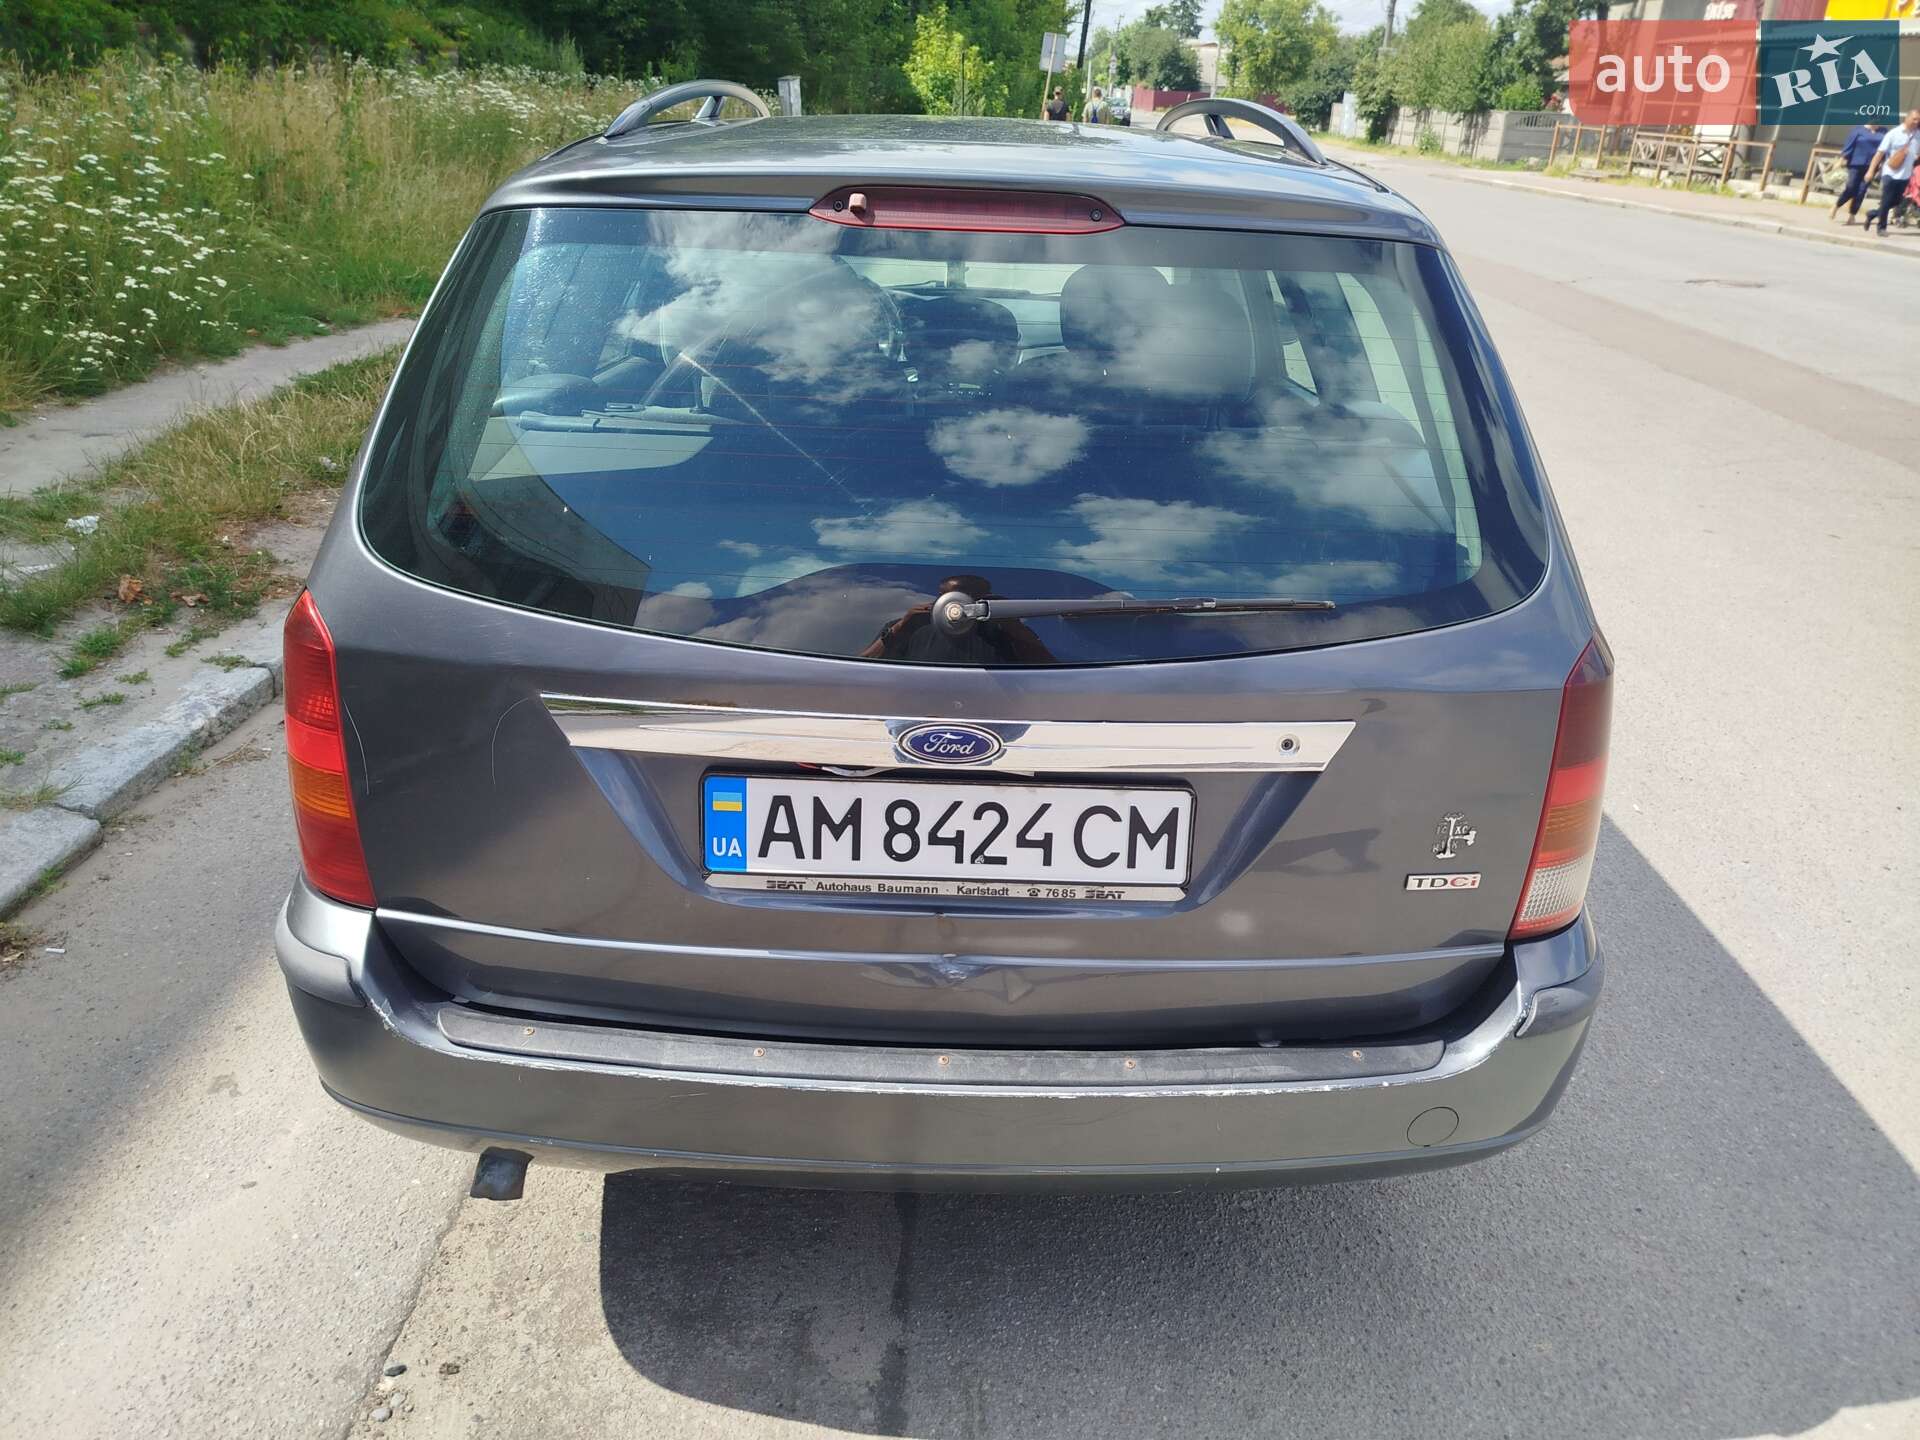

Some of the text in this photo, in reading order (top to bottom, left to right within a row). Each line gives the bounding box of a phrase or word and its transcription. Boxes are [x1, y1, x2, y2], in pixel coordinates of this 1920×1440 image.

[923, 732, 976, 755] Ford
[757, 795, 1180, 871] AM 8424 CM
[712, 837, 742, 858] UA
[766, 879, 807, 891] SEAT
[815, 881, 872, 893] Autohaus
[877, 883, 939, 895] Baumann
[956, 885, 1010, 897] Karlstadt
[1084, 889, 1126, 900] SEAT
[1413, 877, 1477, 888] TDCi
